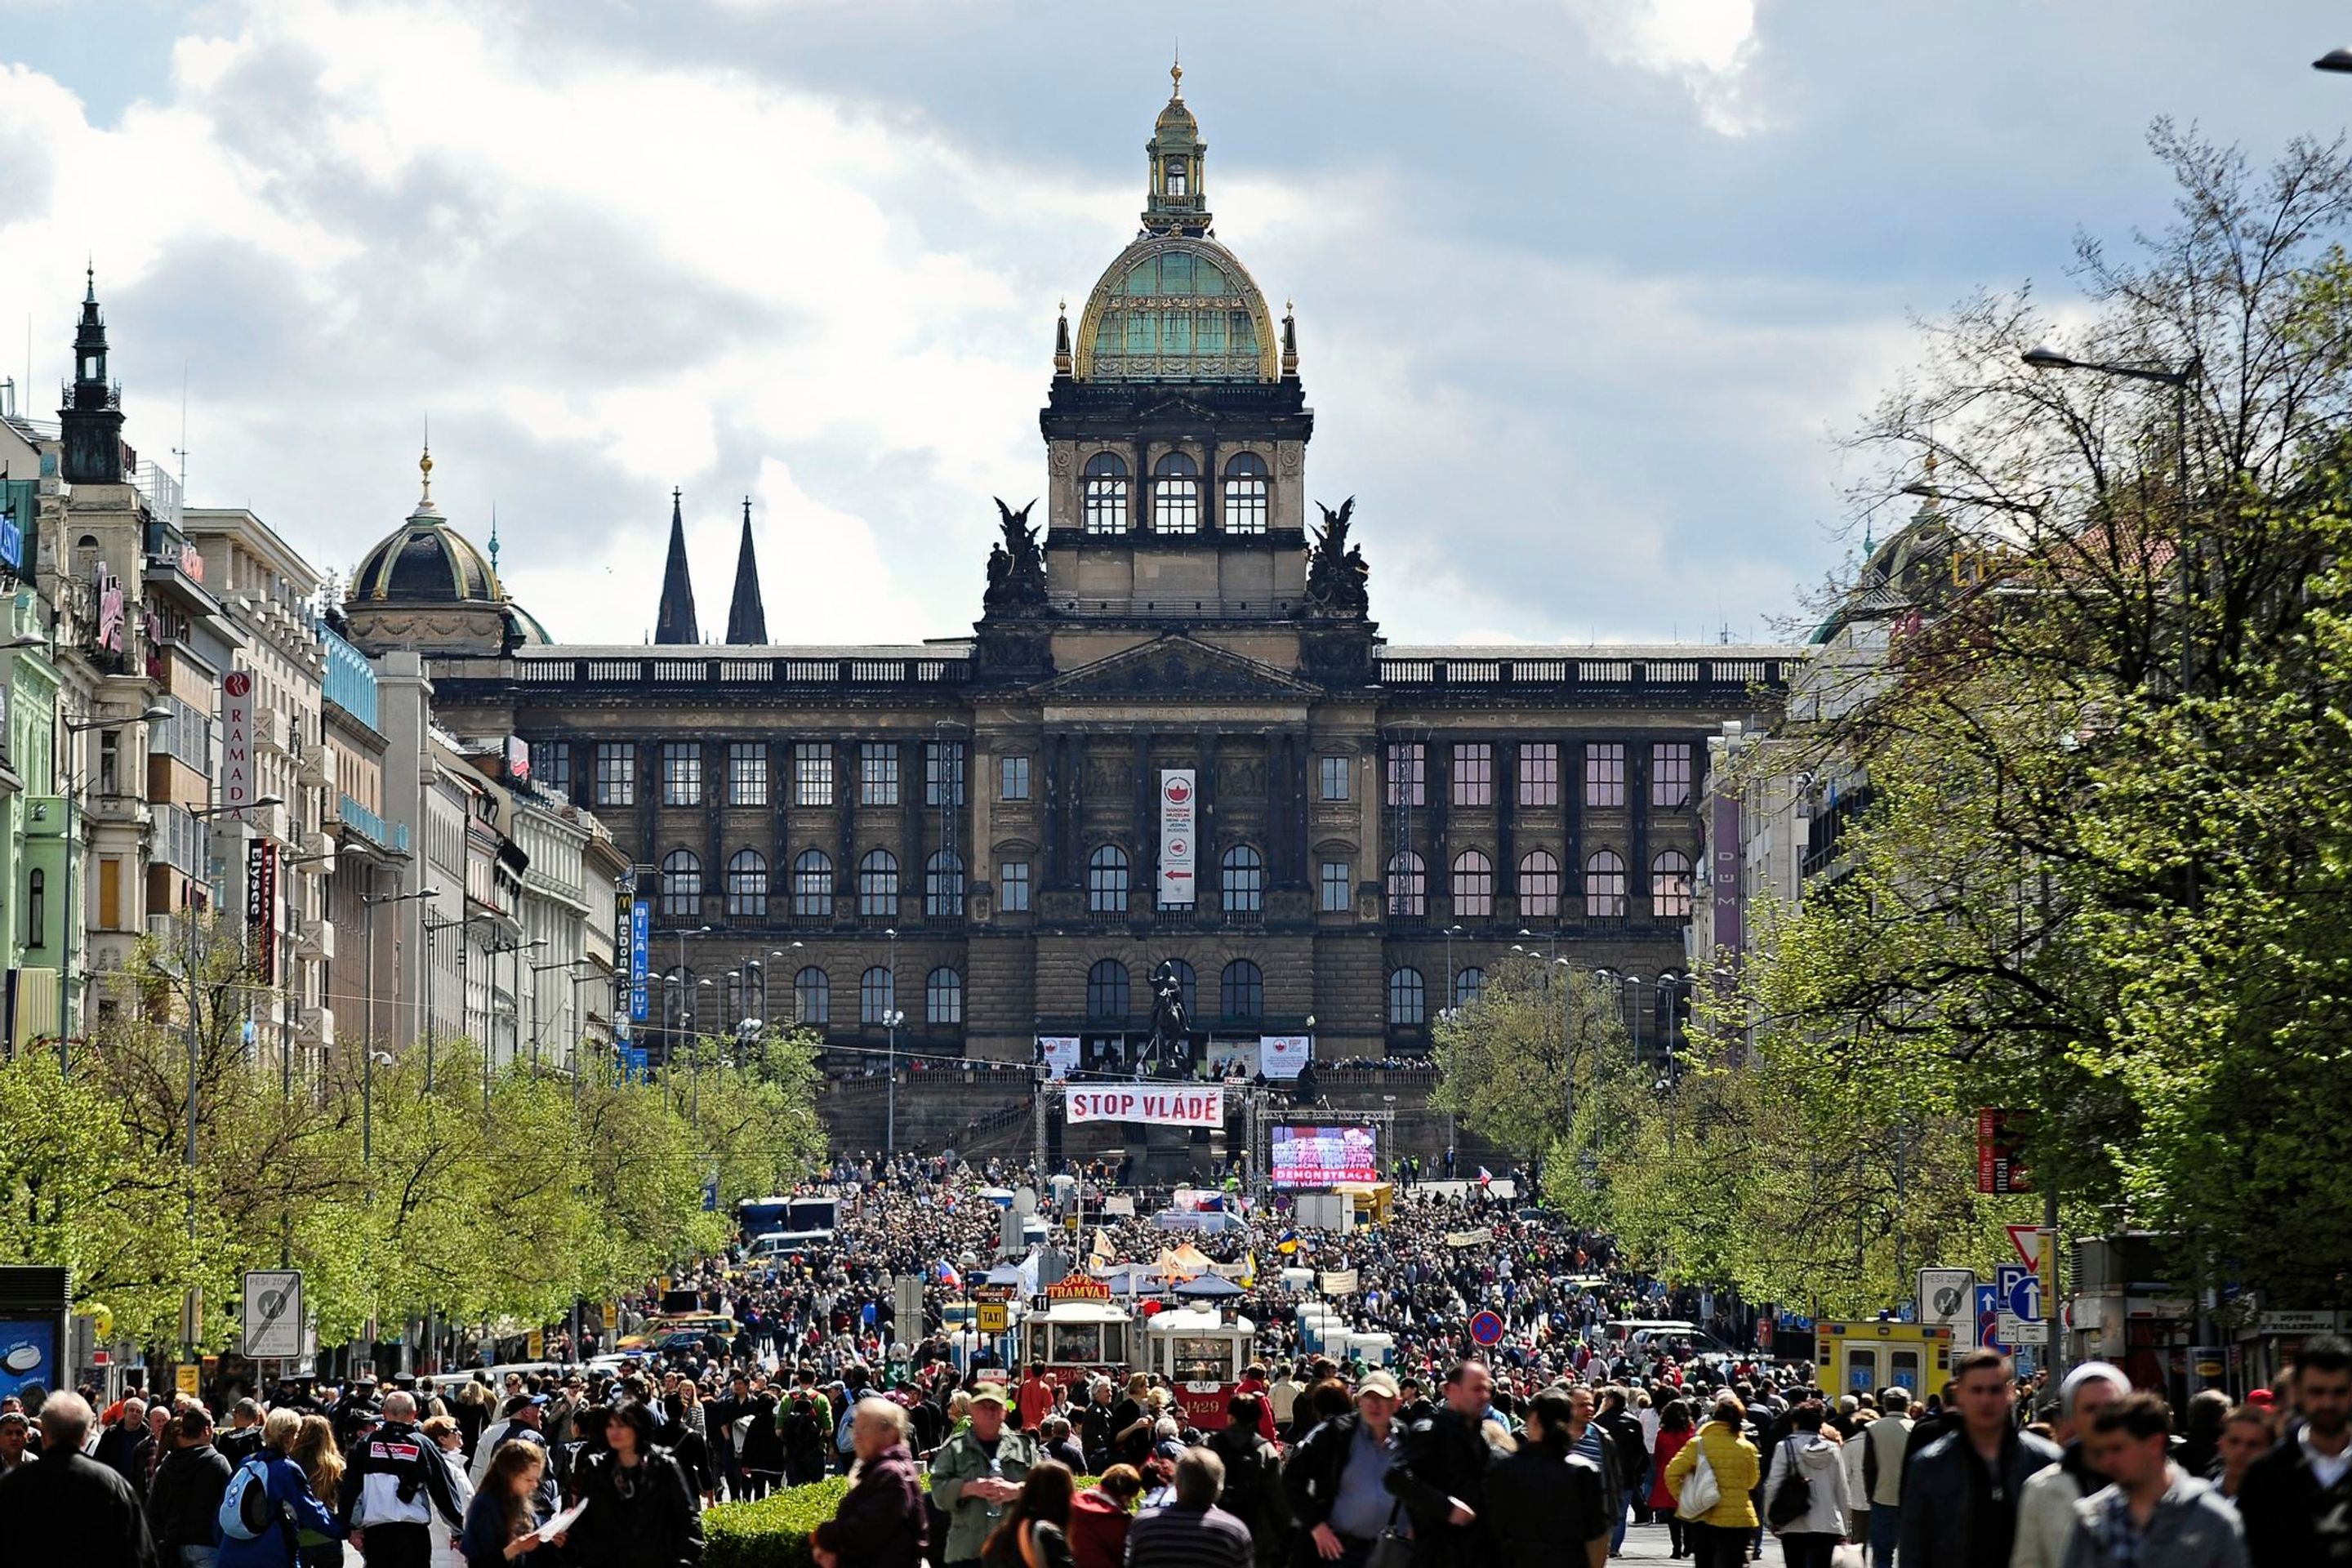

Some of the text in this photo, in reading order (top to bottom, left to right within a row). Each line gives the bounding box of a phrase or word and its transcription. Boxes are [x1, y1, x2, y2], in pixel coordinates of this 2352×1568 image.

[229, 709, 245, 820] RAMADA
[249, 848, 263, 915] Elysee
[1074, 1092, 1218, 1121] STOP VLÁDĚ
[1994, 1158, 2008, 1191] meal
[1049, 1286, 1108, 1298] TRAMVAJ
[1036, 1297, 1047, 1311] 11
[982, 1312, 1001, 1323] TAXI
[1187, 1401, 1219, 1413] 1429
